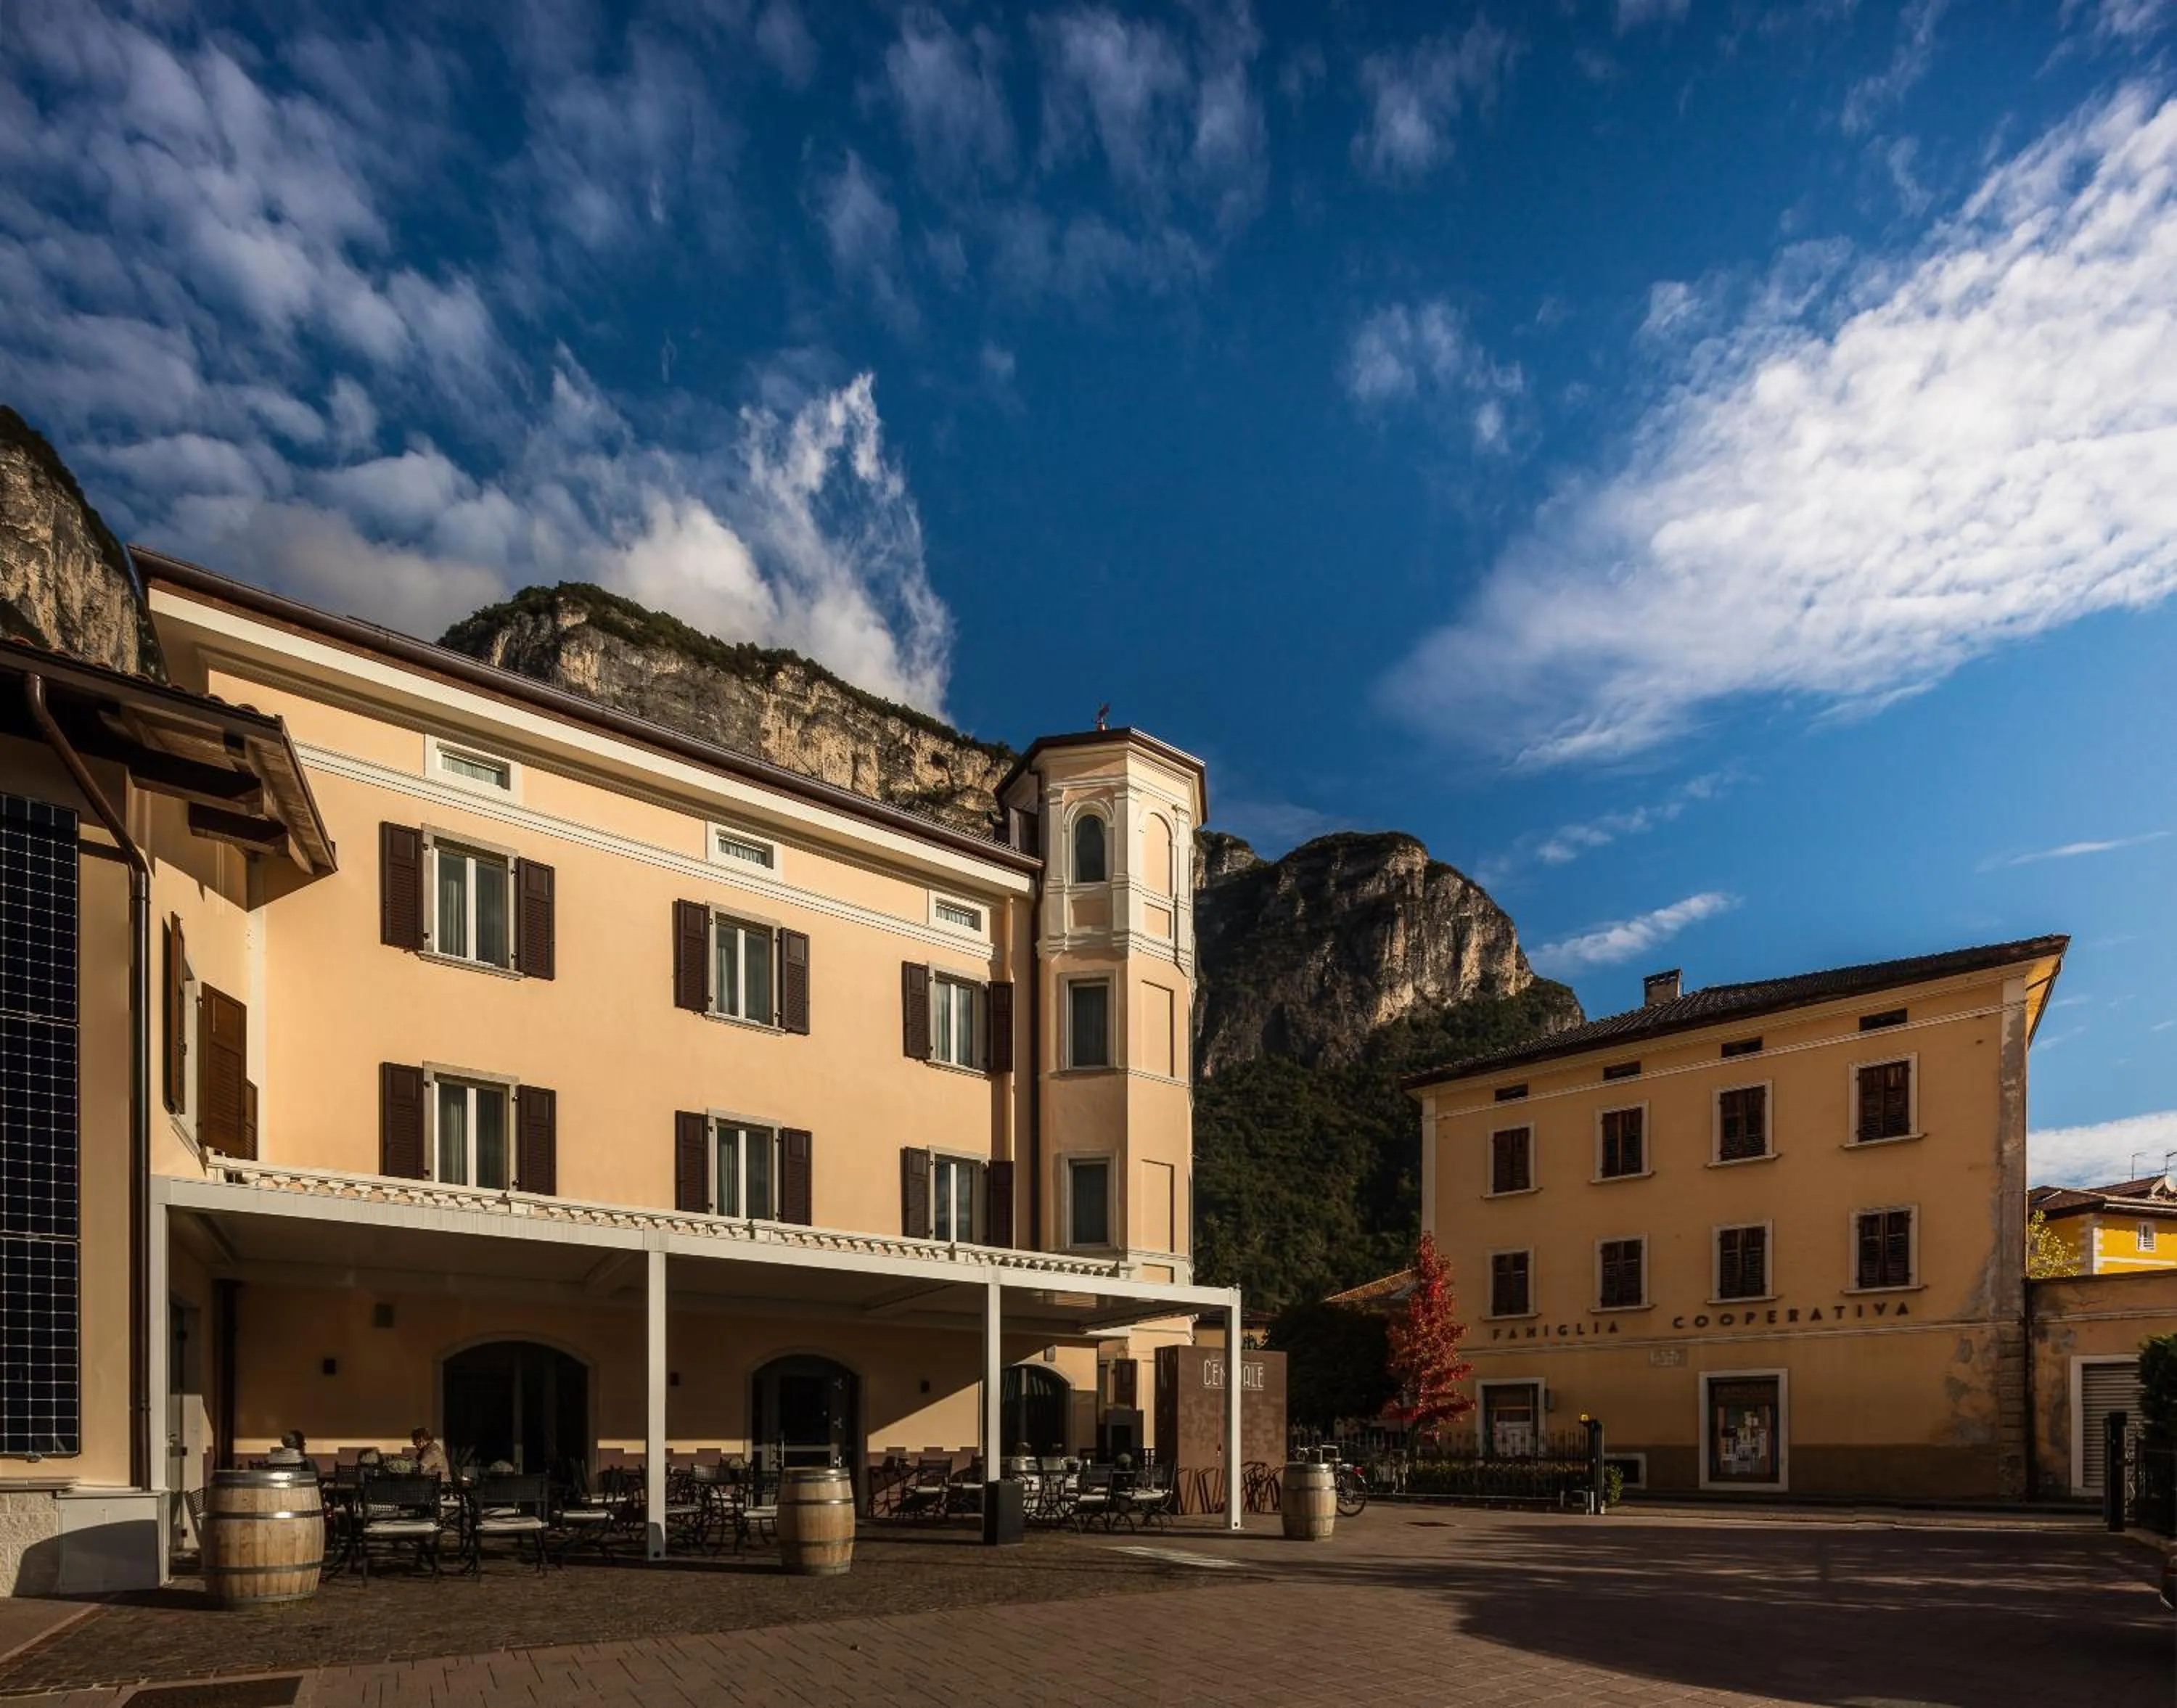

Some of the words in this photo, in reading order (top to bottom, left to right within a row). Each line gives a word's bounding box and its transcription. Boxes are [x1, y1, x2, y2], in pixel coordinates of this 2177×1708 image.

[1493, 1321, 1619, 1341] FAMIGLIA
[1671, 1301, 1909, 1329] COOPERATIVA
[1204, 1359, 1264, 1389] CENALE
